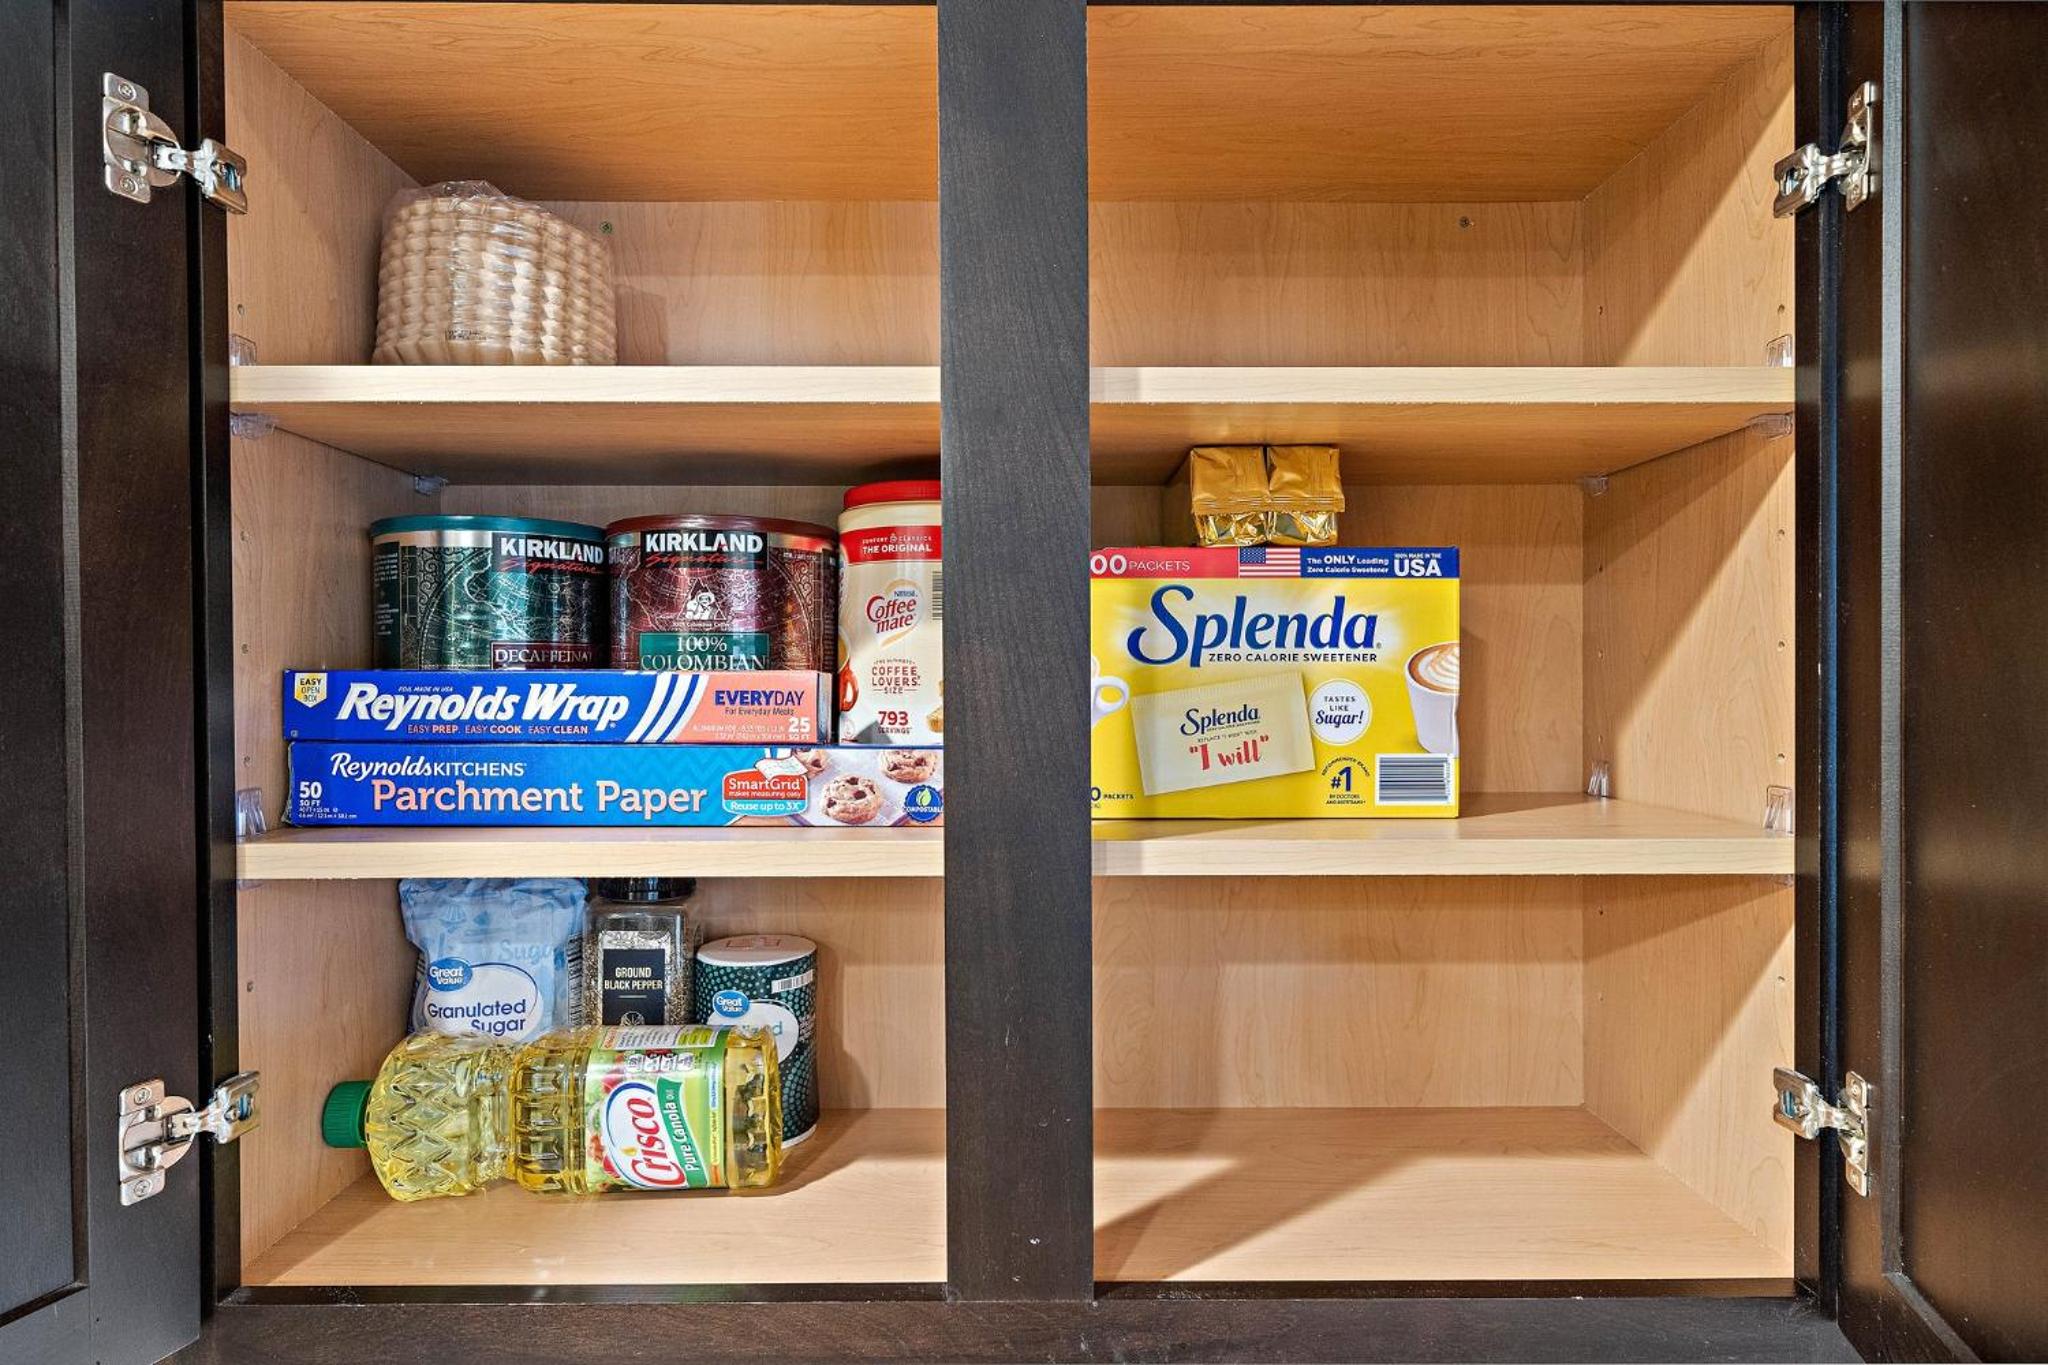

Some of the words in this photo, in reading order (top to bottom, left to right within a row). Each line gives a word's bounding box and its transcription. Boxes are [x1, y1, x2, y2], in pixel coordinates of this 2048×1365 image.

[500, 537, 604, 564] KIRKLAND
[646, 533, 763, 553] KIRKLAND
[863, 546, 879, 554] THE
[882, 544, 933, 552] ORIGINAL
[498, 557, 602, 576] Signature
[644, 553, 764, 567] Signature
[1129, 561, 1191, 571] PACKETS
[1324, 555, 1355, 564] ONLY
[1394, 559, 1442, 577] USA
[867, 596, 917, 622] Coffee
[876, 614, 914, 634] mate
[1127, 584, 1378, 667] Splenda
[677, 635, 728, 652] 100%
[641, 655, 767, 671] COLOMBIAN
[1209, 653, 1242, 662] ZERO
[1246, 653, 1299, 662] CALORIE
[1303, 653, 1377, 662] SWEETENER
[872, 666, 918, 676] COFFEE
[300, 678, 322, 686] EASY
[714, 690, 805, 705] EVERYDAY
[335, 682, 521, 732] Reynolds
[521, 682, 629, 732] Wrap
[738, 707, 771, 716] Everyday
[788, 717, 811, 733] 25
[878, 711, 909, 726] 793
[1180, 704, 1259, 736] Splenda
[1315, 709, 1364, 728] Sugar!
[408, 725, 430, 734] EASY
[465, 725, 488, 734] EASY
[529, 725, 551, 734] EASY
[729, 778, 802, 790] SmartGrid
[1331, 766, 1352, 791] #1
[300, 781, 322, 799] 50
[371, 779, 583, 811] Parchment
[596, 780, 708, 820] Paper
[731, 802, 759, 810] Reuse
[761, 803, 774, 811] up
[774, 802, 785, 810] to
[429, 966, 464, 979] Great
[615, 967, 651, 978] GROUND
[437, 977, 463, 986] Value
[604, 980, 630, 990] BLACK
[631, 979, 663, 990] PEPPER
[427, 998, 526, 1018] Granulated
[716, 996, 743, 1007] Great
[471, 1018, 526, 1036] Sugar
[669, 1101, 688, 1144] Canola
[683, 1146, 700, 1172] Pure
